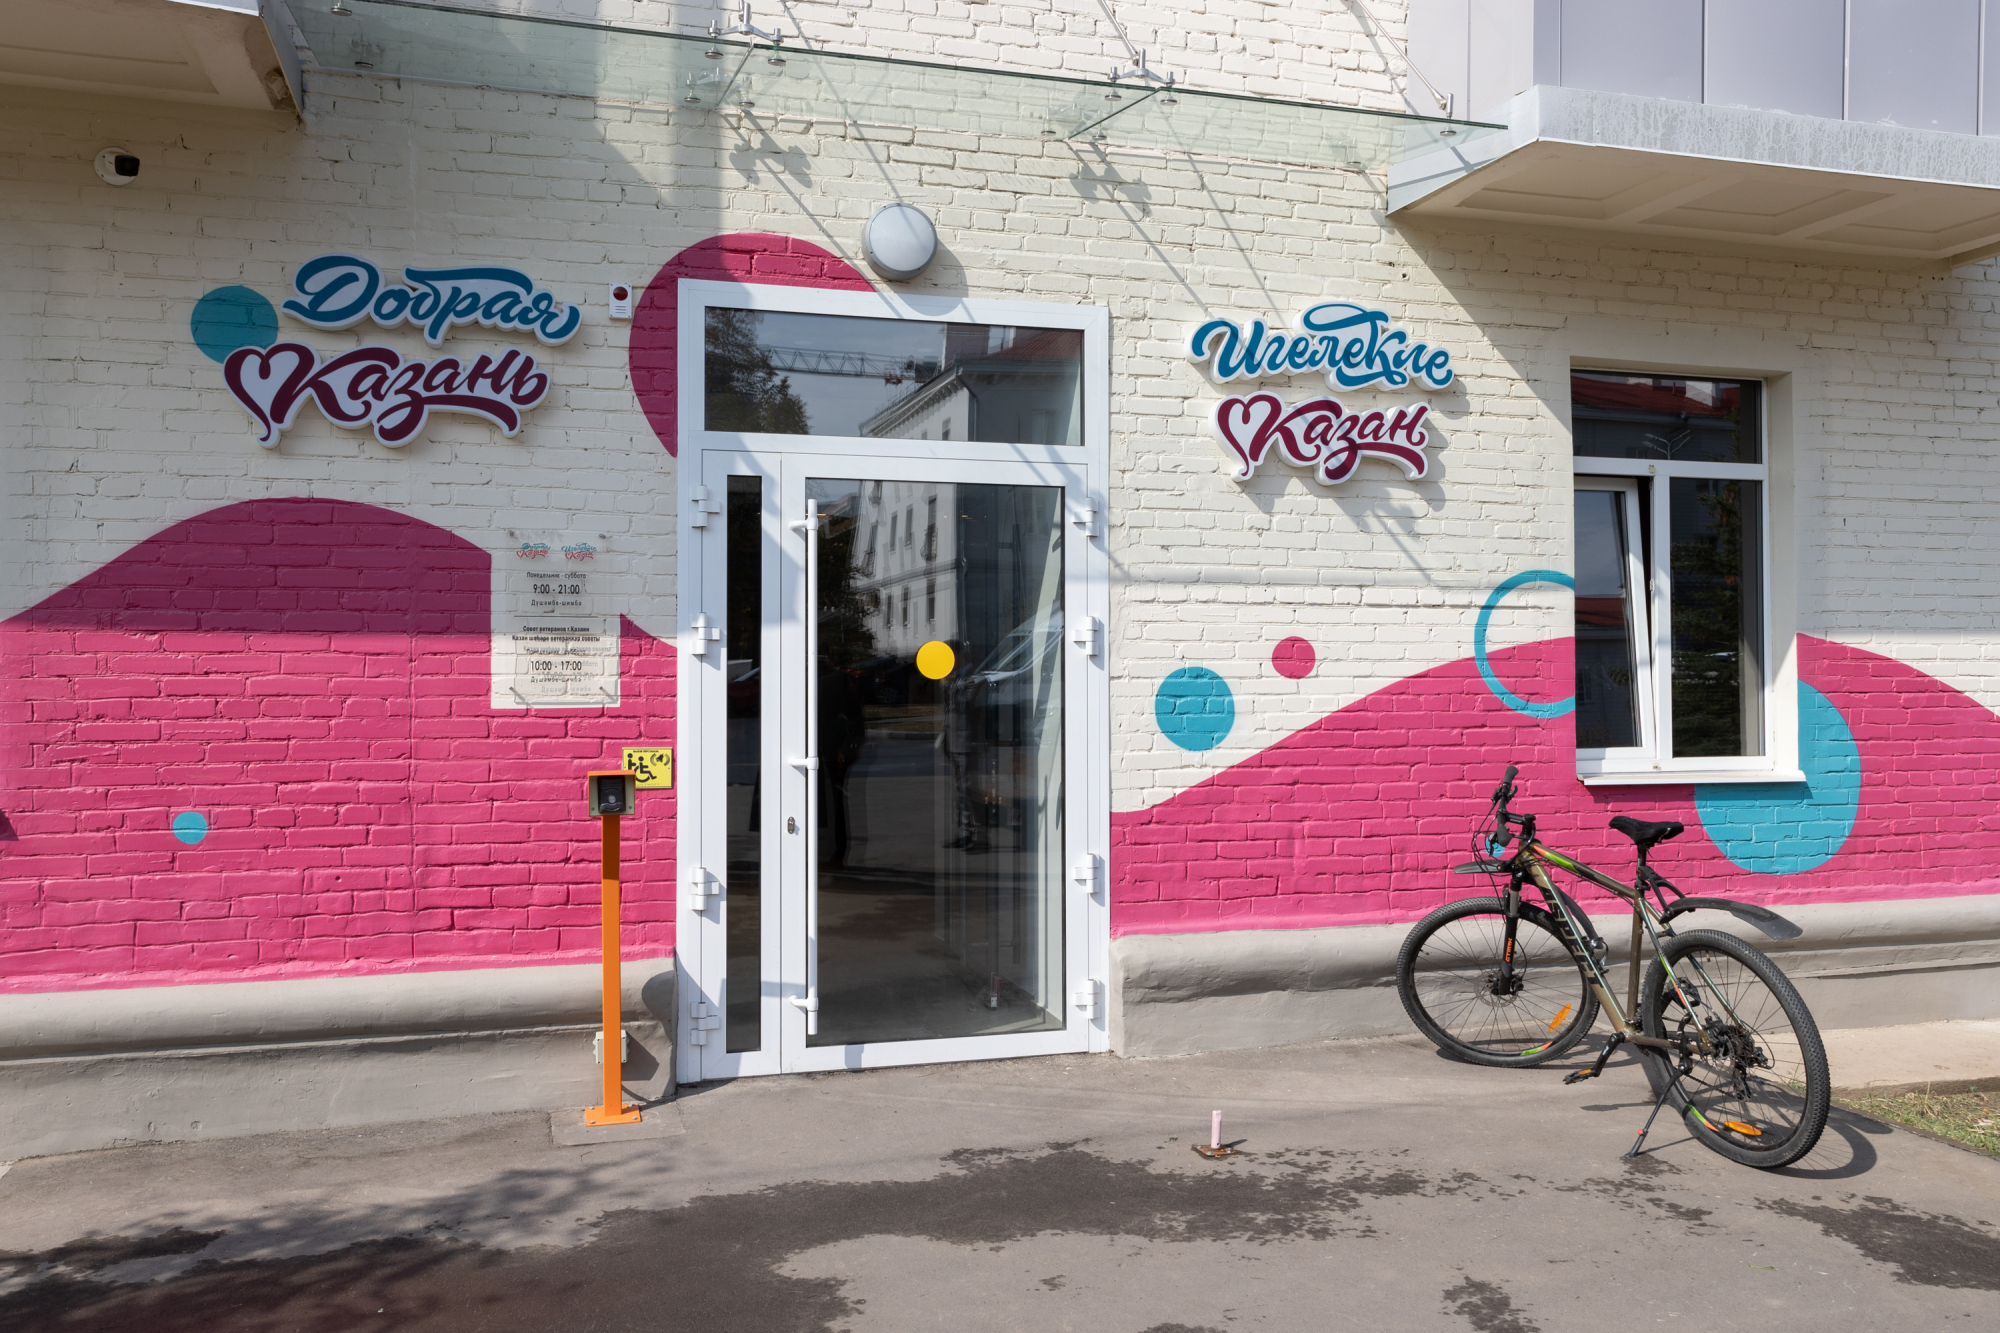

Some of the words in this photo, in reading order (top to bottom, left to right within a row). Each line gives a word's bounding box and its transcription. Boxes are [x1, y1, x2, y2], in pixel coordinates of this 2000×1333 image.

[281, 254, 582, 343] Добрая
[1190, 303, 1454, 387] Игелекле
[223, 342, 549, 442] Казань
[1217, 394, 1427, 480] Казан
[526, 571, 560, 579] Понедельник
[564, 572, 587, 580] суббота
[533, 583, 550, 594] 9:00
[558, 584, 580, 595] 21:00
[530, 660, 552, 671] 10:00
[560, 660, 582, 671] 17:00
